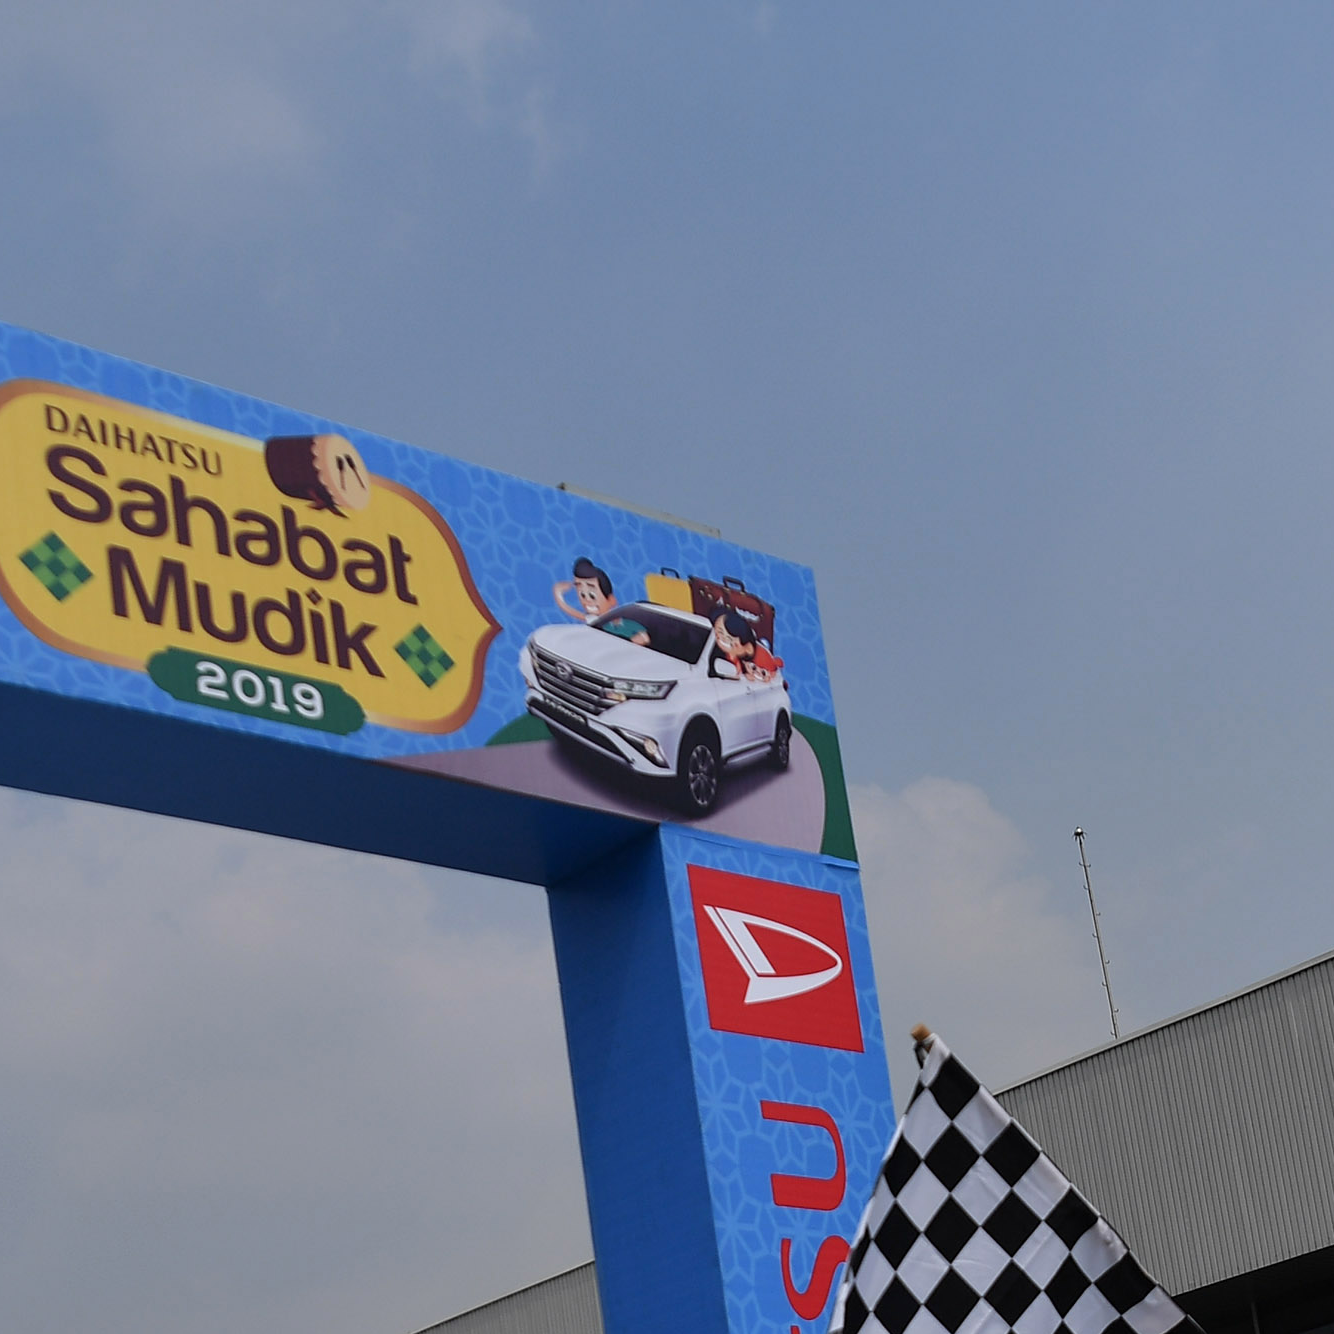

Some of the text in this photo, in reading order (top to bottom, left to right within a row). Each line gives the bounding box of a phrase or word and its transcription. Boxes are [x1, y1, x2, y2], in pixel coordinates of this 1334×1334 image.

[44, 404, 223, 476] DAIHATSU
[47, 443, 418, 606] Sahabat
[107, 544, 386, 678] Mudik
[195, 661, 325, 721] 2019
